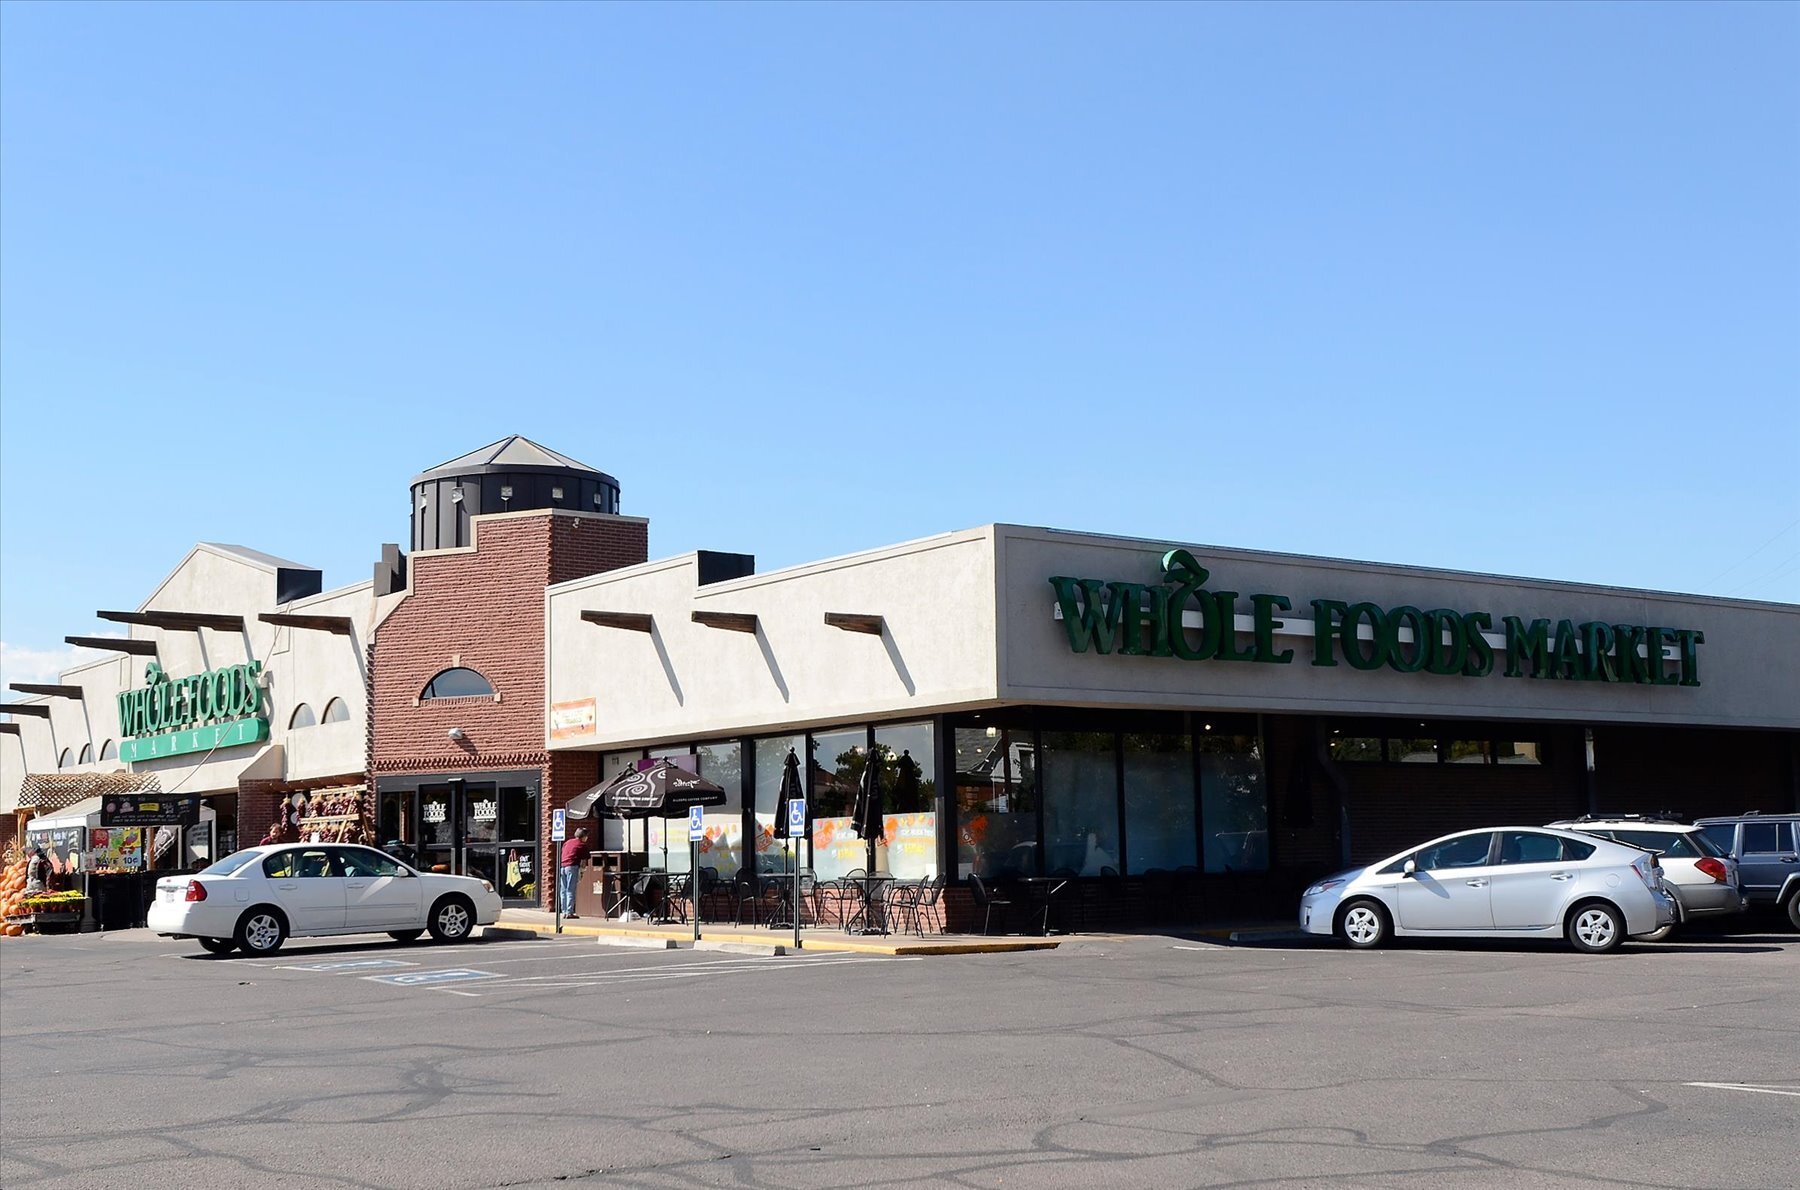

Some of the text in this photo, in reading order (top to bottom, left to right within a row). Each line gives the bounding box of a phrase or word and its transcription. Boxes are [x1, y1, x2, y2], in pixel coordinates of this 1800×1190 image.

[1048, 574, 1704, 687] WHOLE FOODS MARKET
[117, 660, 262, 737] WHOLE FOODS
[130, 723, 244, 759] MARKET
[422, 803, 446, 811] WHOLE
[473, 801, 497, 810] WHOLE
